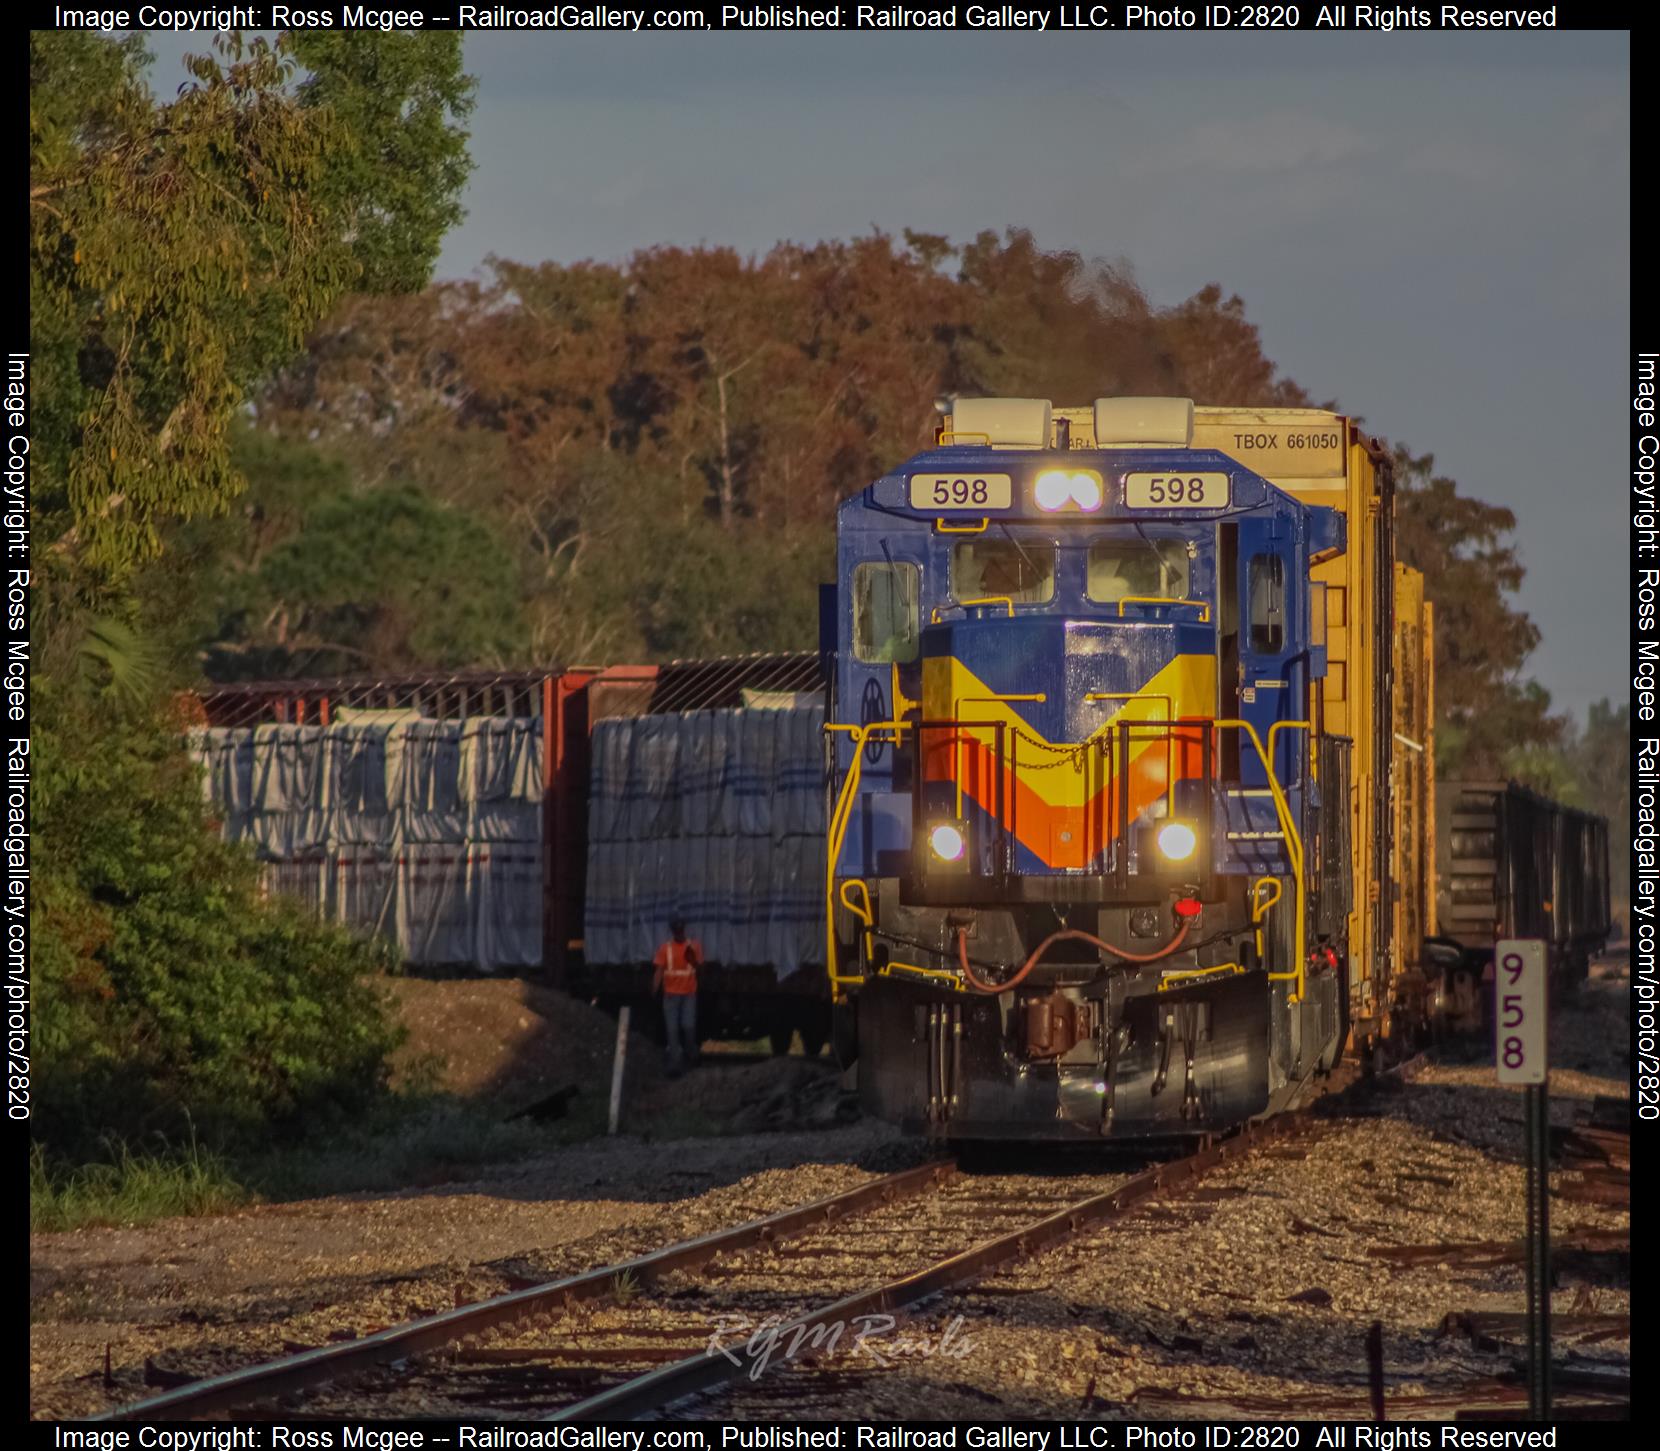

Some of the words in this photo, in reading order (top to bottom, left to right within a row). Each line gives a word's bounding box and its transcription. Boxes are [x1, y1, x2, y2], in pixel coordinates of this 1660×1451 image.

[1234, 434, 1278, 449] TBOX
[1287, 434, 1338, 449] 661050
[933, 479, 988, 504] 598
[1149, 478, 1204, 503] 598
[1502, 953, 1524, 1069] 958
